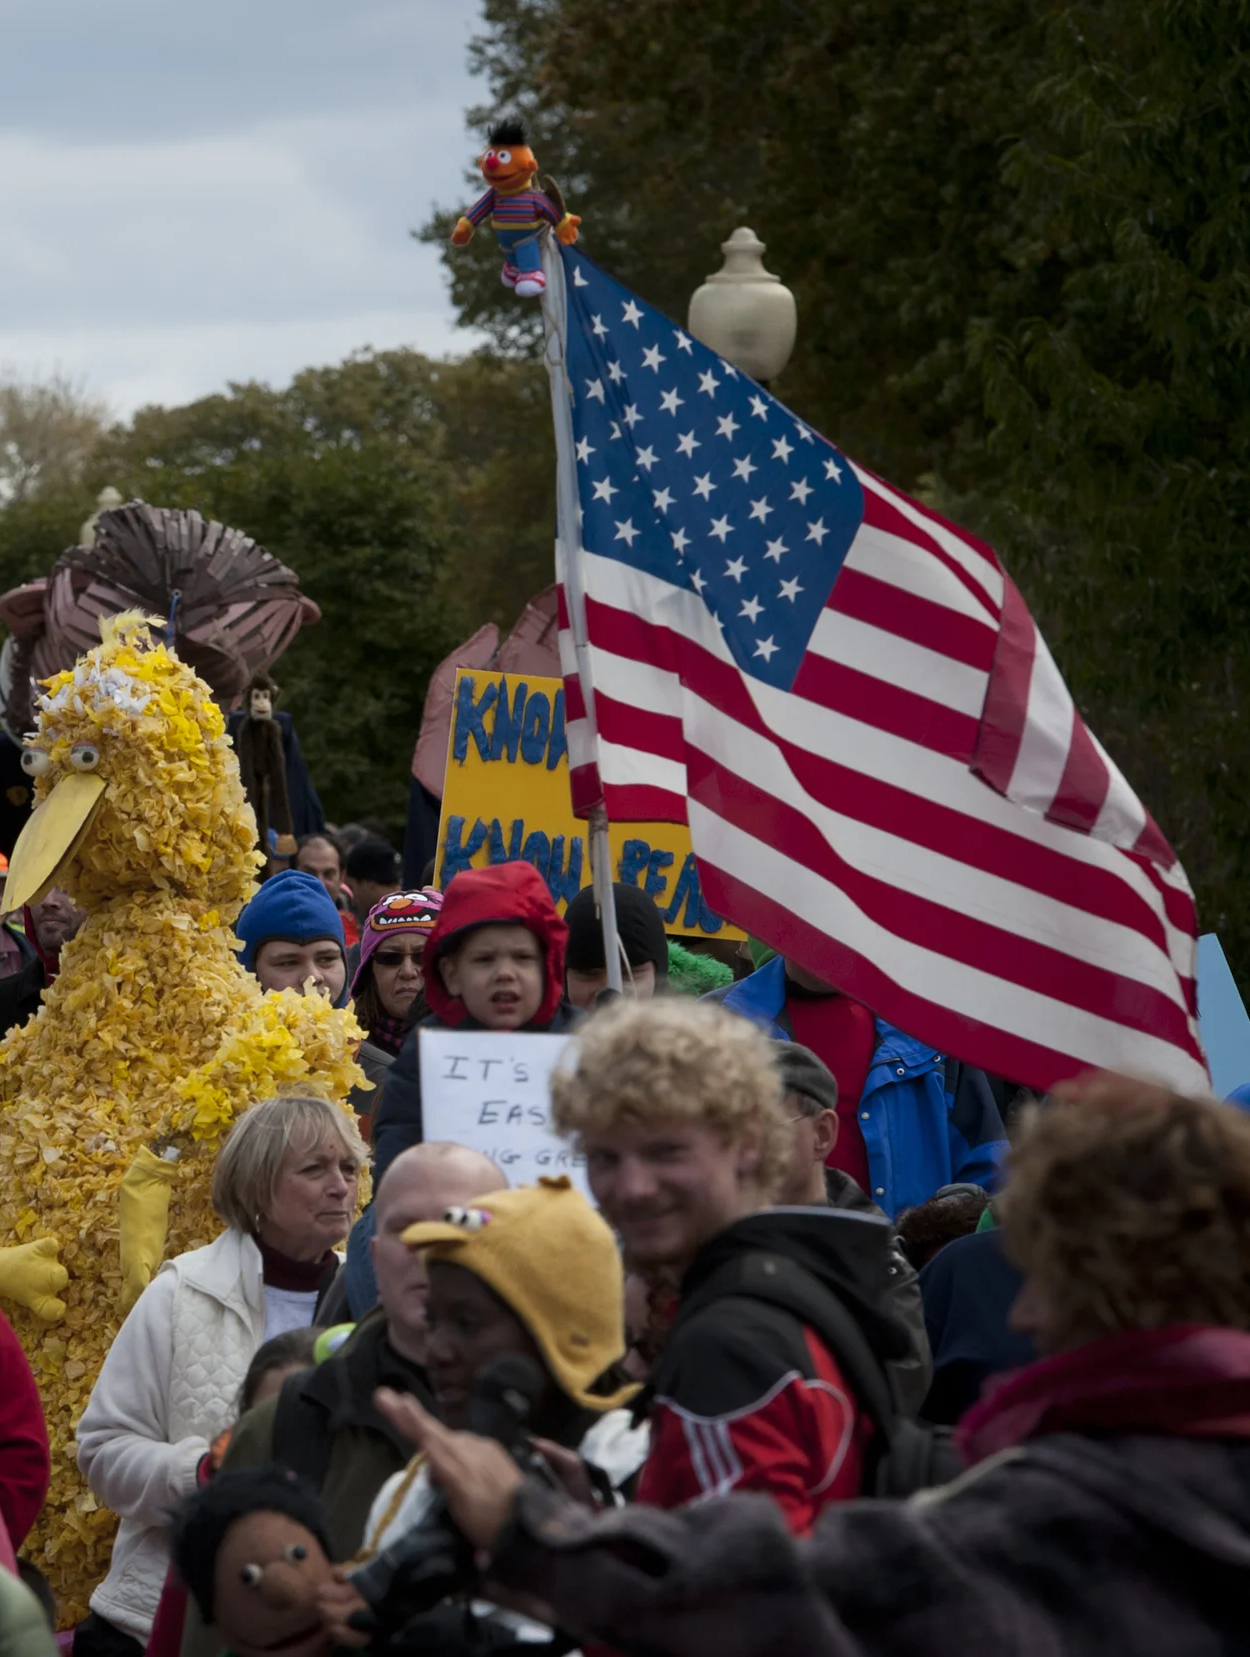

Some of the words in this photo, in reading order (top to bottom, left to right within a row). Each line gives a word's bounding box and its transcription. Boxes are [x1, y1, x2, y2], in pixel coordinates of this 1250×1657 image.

[617, 839, 731, 934] PEA
[442, 1055, 529, 1082] IT'S
[477, 1100, 547, 1126] EAS
[535, 1148, 587, 1168] GRE
